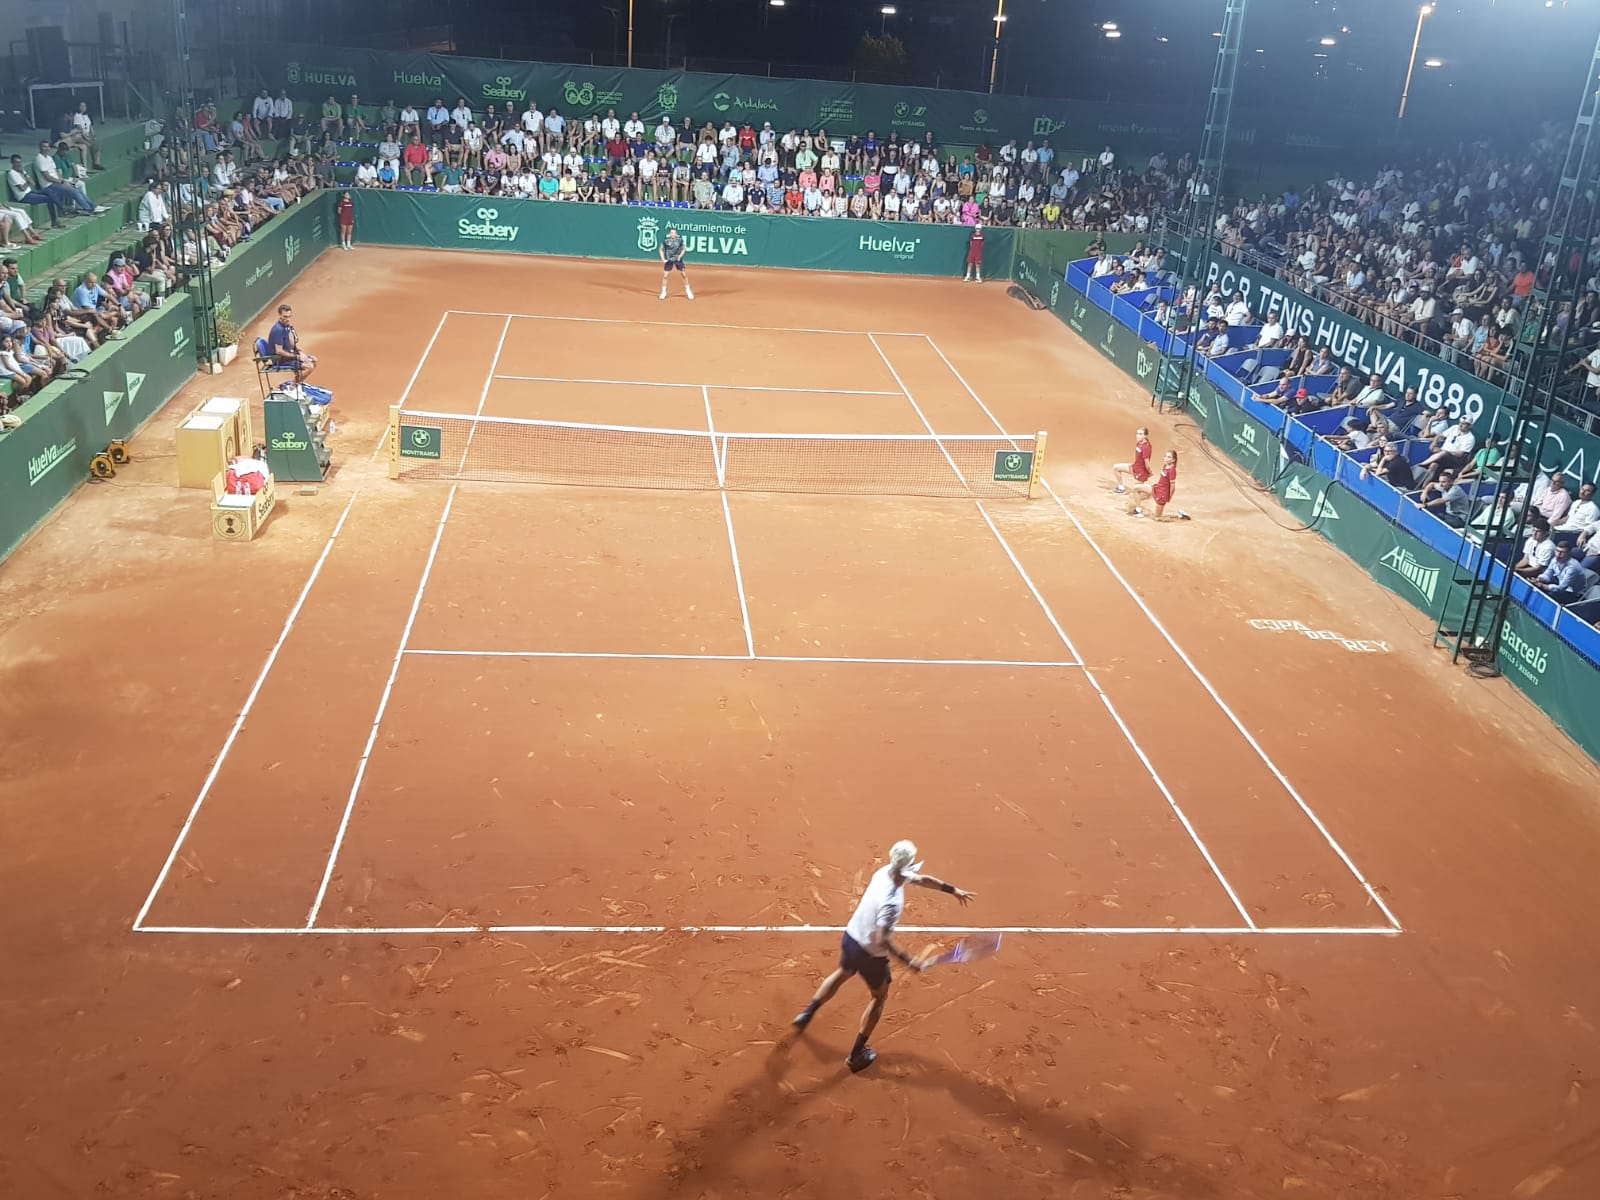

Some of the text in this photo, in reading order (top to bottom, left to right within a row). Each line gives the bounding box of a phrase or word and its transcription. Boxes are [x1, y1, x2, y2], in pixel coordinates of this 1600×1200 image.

[304, 72, 357, 87] HUELVA
[394, 71, 441, 86] Huelva
[482, 83, 527, 102] Seabery
[458, 218, 519, 241] Seabery
[665, 220, 747, 235] Ayuntamiento de
[859, 235, 915, 253] Huelva
[1258, 285, 1314, 337] TENIS
[1314, 316, 1405, 393] HUELVA
[1416, 367, 1483, 425] 1889
[272, 438, 308, 451] Seabery
[28, 443, 57, 480] Huelva
[1305, 630, 1345, 641] DEL
[1342, 640, 1390, 652] REY
[1500, 620, 1549, 674] Barceló
